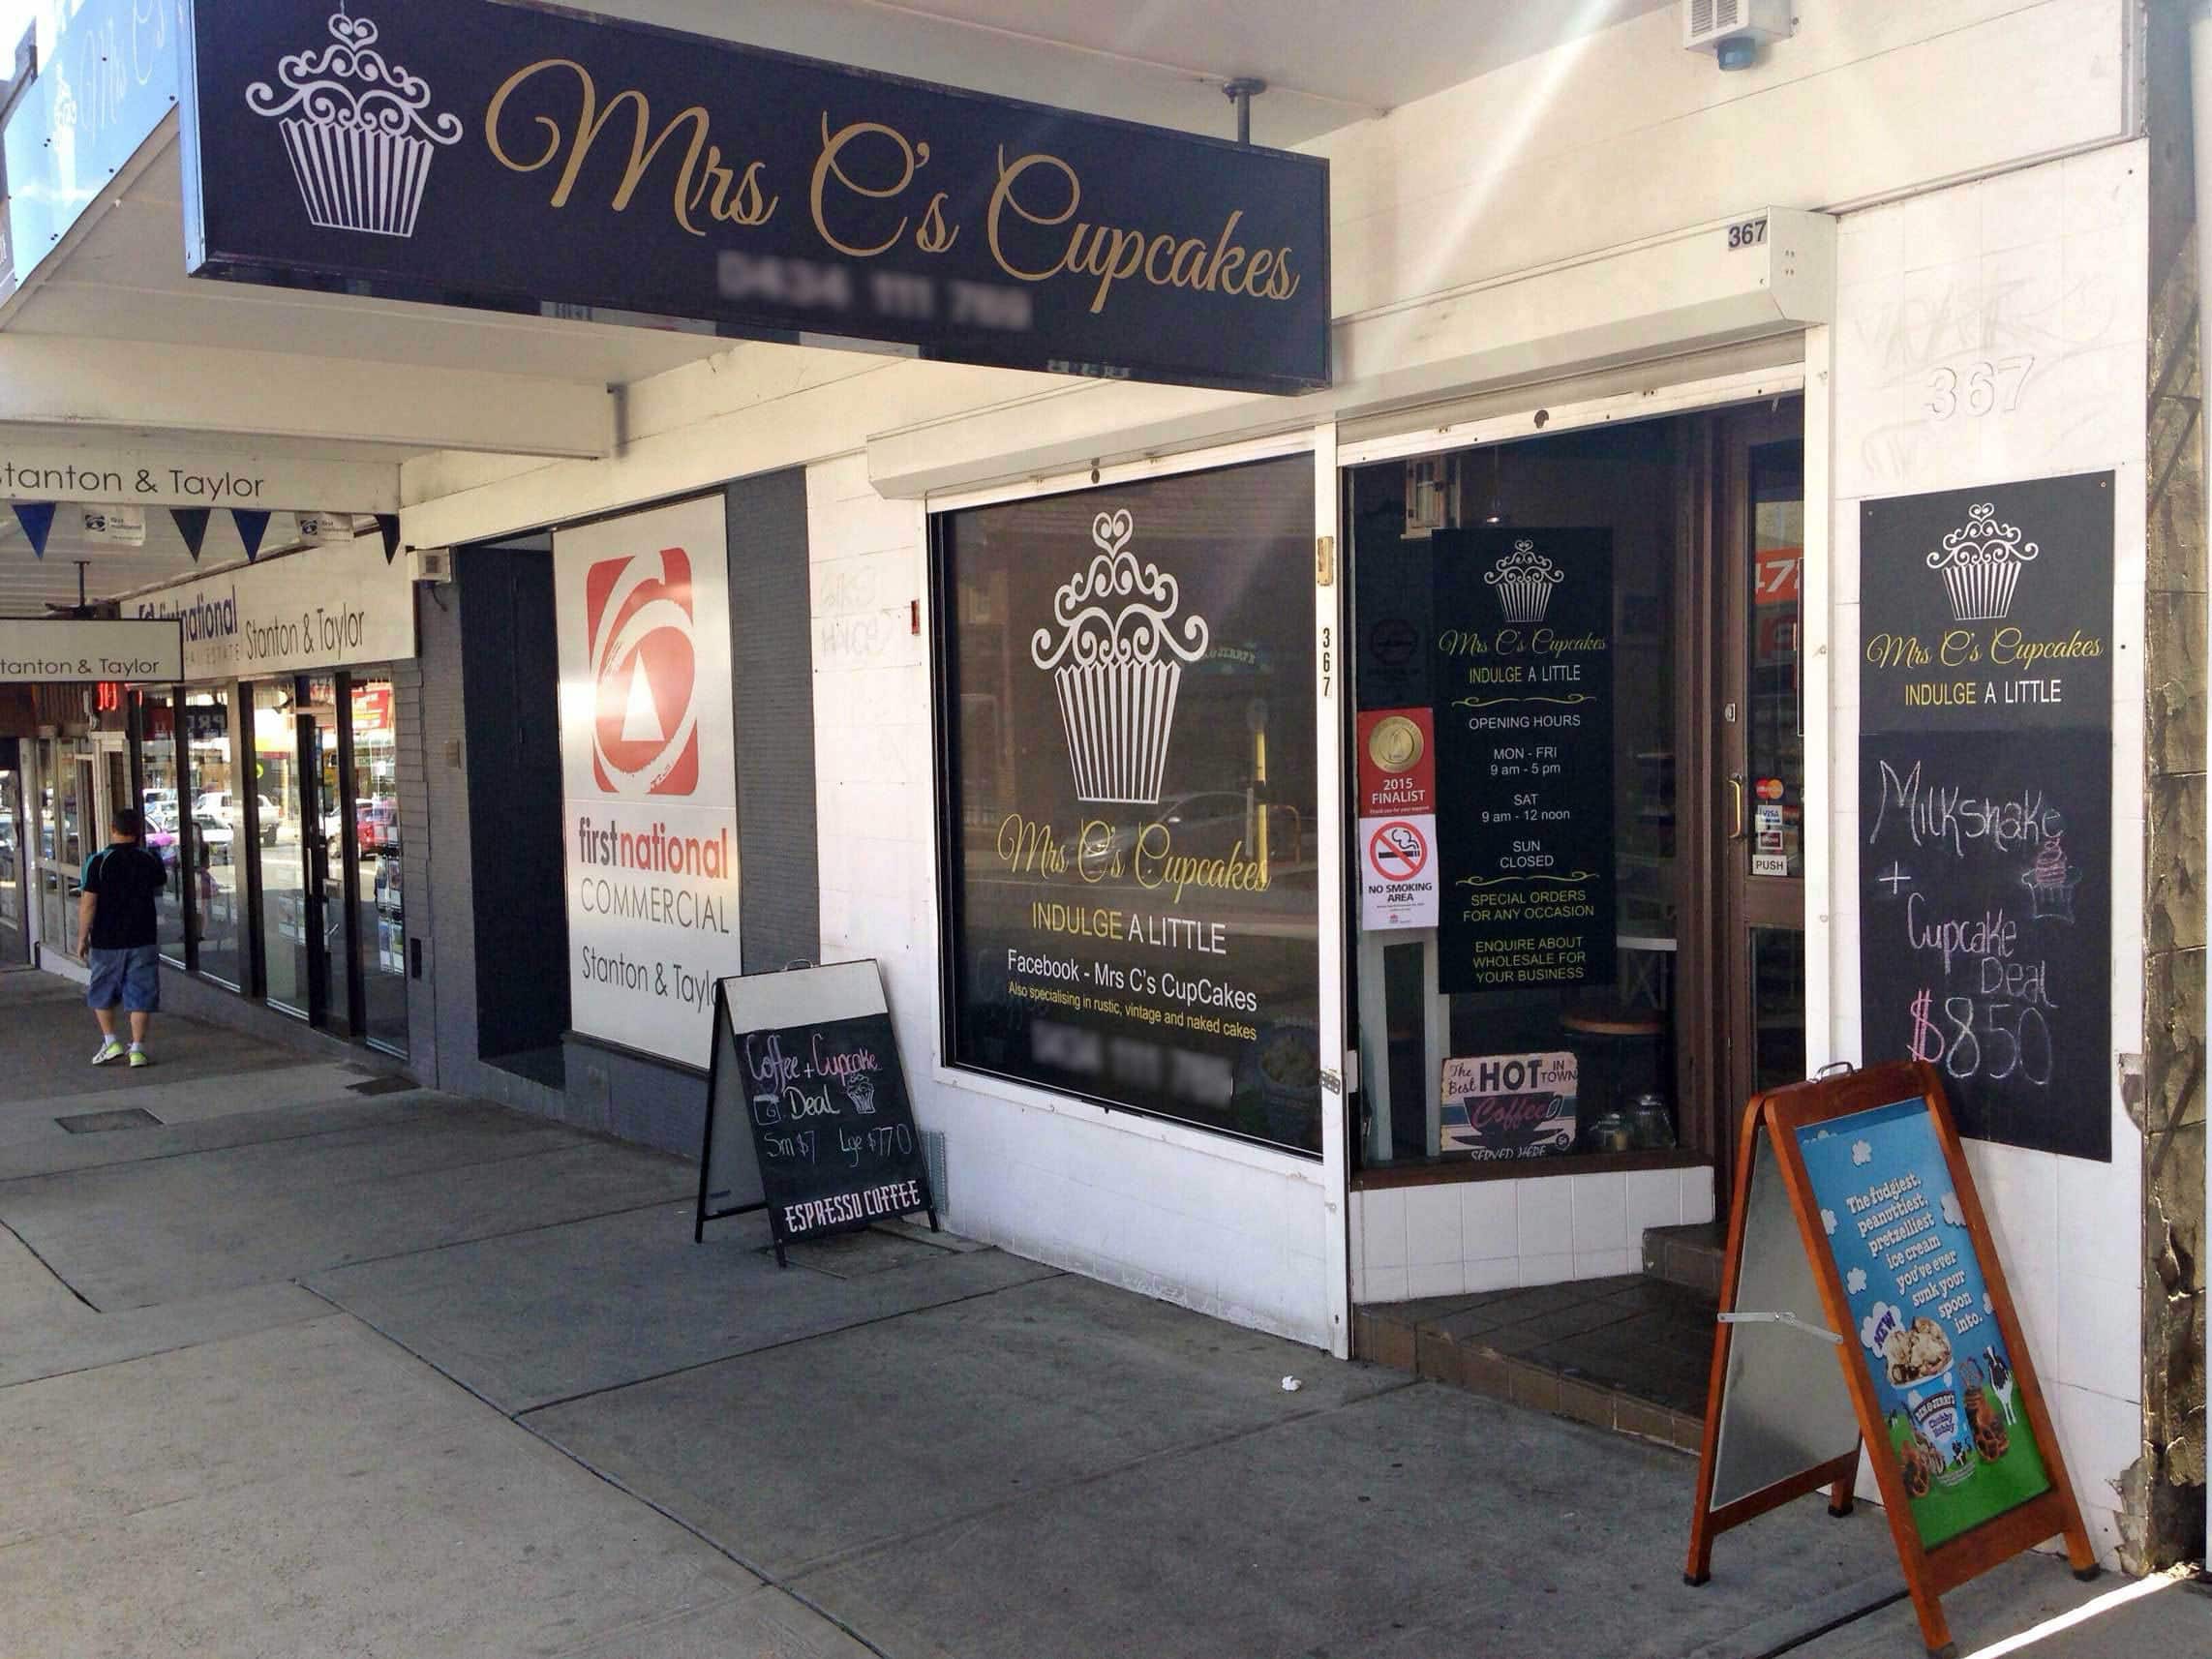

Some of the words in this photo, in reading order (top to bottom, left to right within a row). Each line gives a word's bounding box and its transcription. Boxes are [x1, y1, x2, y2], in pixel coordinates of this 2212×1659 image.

[485, 58, 778, 235] Mrs
[810, 110, 960, 256] C's
[987, 143, 1301, 314] Cupcakes
[1729, 220, 1767, 248] 367
[1923, 355, 2036, 422] 367
[0, 462, 122, 492] tanton
[135, 468, 159, 493] &
[168, 468, 264, 501] Taylor
[246, 615, 299, 660] Stanton
[303, 613, 314, 653] &
[317, 602, 365, 660] Taylor
[1439, 629, 1488, 656] Mrs
[1496, 629, 1526, 655] C's
[1531, 628, 1606, 658] Cupcakes
[1866, 633, 1933, 669] Mrs
[1940, 630, 1984, 667] C's
[1990, 627, 2104, 670] Cupcakes
[0, 658, 73, 675] tanton
[77, 659, 92, 674] &
[99, 658, 160, 676] Taylor
[1470, 665, 1523, 683] INDULGE
[1528, 665, 1537, 681] A
[1542, 664, 1581, 681] LITTLE
[1905, 681, 1977, 706] INDULGE
[1984, 681, 1997, 705] A
[2005, 679, 2062, 703] LITTLE
[1469, 716, 1530, 730] OPENING
[1533, 714, 1581, 728] HOURS
[1494, 747, 1525, 760] MON
[1536, 746, 1558, 759] FRI
[1383, 777, 1413, 792] 2015
[1490, 764, 1499, 776] 9
[1501, 766, 1520, 775] am
[1531, 763, 1539, 774] 5
[1542, 764, 1561, 777] pm
[1372, 790, 1426, 805] FINALIST
[1513, 794, 1539, 806] SAT
[1870, 760, 2064, 859] Milkshake
[1481, 811, 1489, 823] 9
[1493, 812, 1511, 822] am
[1524, 809, 1538, 821] 12
[1541, 809, 1570, 821] noon
[997, 813, 1069, 880] Mrs
[1077, 818, 1126, 883] C's
[1135, 821, 1271, 904] Cupcakes
[1500, 855, 1555, 868] CLOSED
[1512, 840, 1540, 853] SUN
[1756, 860, 1783, 871] PUSH
[1368, 885, 1383, 894] NO
[1385, 882, 1433, 893] SMOKING
[1387, 892, 1414, 903] AREA
[1471, 892, 1527, 906] SPECIAL
[1530, 890, 1587, 904] ORDERS
[581, 877, 730, 934] COMMERCIAL
[1463, 909, 1491, 921] FOR
[1494, 908, 1521, 920] ANY
[1524, 905, 1594, 920] OCCASION
[1032, 901, 1124, 940] INDULGE
[1128, 913, 1144, 943] A
[1149, 915, 1227, 955] LITTLE
[1907, 892, 2017, 976] Cupcake
[1472, 952, 1557, 968] WHOLESALE
[1559, 950, 1587, 963] FOR
[1475, 938, 1535, 953] ENQUIRE
[1538, 936, 1584, 950] ABOUT
[582, 946, 649, 992] Stanton
[654, 962, 668, 996] &
[1008, 949, 1080, 982] Facebook
[1094, 961, 1124, 990] Mrs
[1130, 967, 1156, 995] C's
[1162, 972, 1258, 1012] CupCakes
[1475, 970, 1514, 983] YOUR
[1517, 967, 1585, 981] BUSINESS
[1981, 956, 2058, 1008] Deal
[1008, 980, 1027, 999] Also
[1029, 986, 1081, 1010] specialising
[1083, 995, 1092, 1008] in
[1094, 999, 1123, 1017] rustic,
[1125, 1003, 1162, 1025] vintage
[1165, 1011, 1184, 1028] and
[1187, 1015, 1221, 1034] naked
[1224, 1022, 1258, 1041] cakes
[745, 1033, 800, 1091] Coffee
[812, 1032, 879, 1086] Cupcake
[1451, 1063, 1471, 1077] The
[1479, 1059, 1542, 1093] HOT
[1553, 1060, 1564, 1071] IN
[1448, 1078, 1476, 1095] Best
[1540, 1069, 1578, 1083] TOWN
[783, 1084, 840, 1121] Deal
[1471, 1097, 1545, 1131] Coffee
[764, 1132, 795, 1158] Sm
[839, 1127, 864, 1167] Lge
[785, 1191, 864, 1233] ESPRESSO
[865, 1180, 921, 1221] COFFEE
[1846, 1194, 1870, 1214] The
[1868, 1211, 1935, 1257] pretzelliest
[1886, 1250, 1905, 1270] ice
[1905, 1235, 1941, 1260] cream
[1895, 1263, 1932, 1295] you've
[1934, 1250, 1957, 1271] ever
[1912, 1282, 1940, 1307] sunk
[1939, 1270, 1965, 1298] your
[1938, 1292, 1973, 1318] spoon
[1873, 1310, 1897, 1349] NEW
[1954, 1312, 1984, 1335] into.
